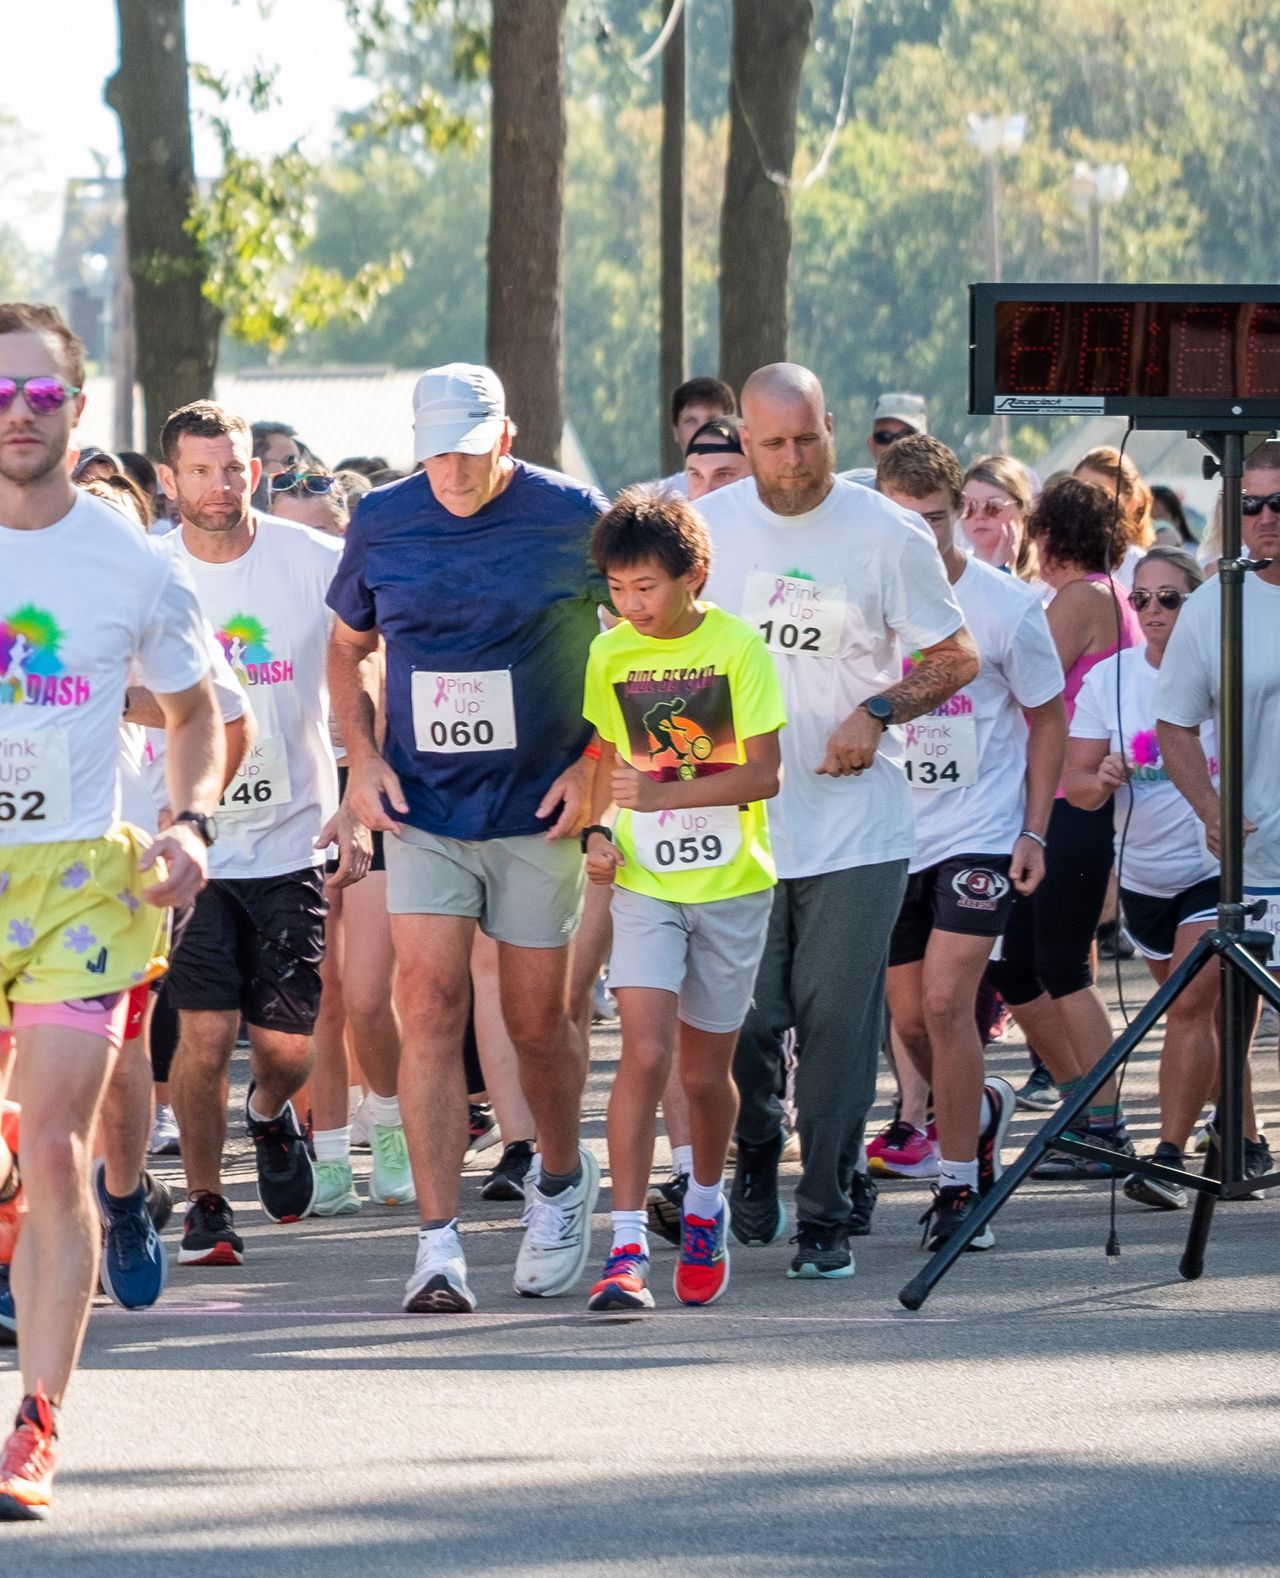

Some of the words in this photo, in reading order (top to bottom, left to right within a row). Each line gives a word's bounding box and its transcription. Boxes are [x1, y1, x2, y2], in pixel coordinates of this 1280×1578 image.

[786, 582, 821, 602] Pink
[790, 602, 813, 622] Up
[759, 620, 821, 651] 102
[246, 660, 293, 685] DASH
[23, 674, 91, 707] DASH
[446, 678, 484, 694] Pink
[454, 698, 481, 717] Up
[430, 719, 494, 747] 060
[916, 724, 952, 739] Pink
[923, 742, 948, 759] Up
[904, 760, 960, 784] 134
[681, 814, 708, 832] Up
[655, 834, 722, 866] 059
